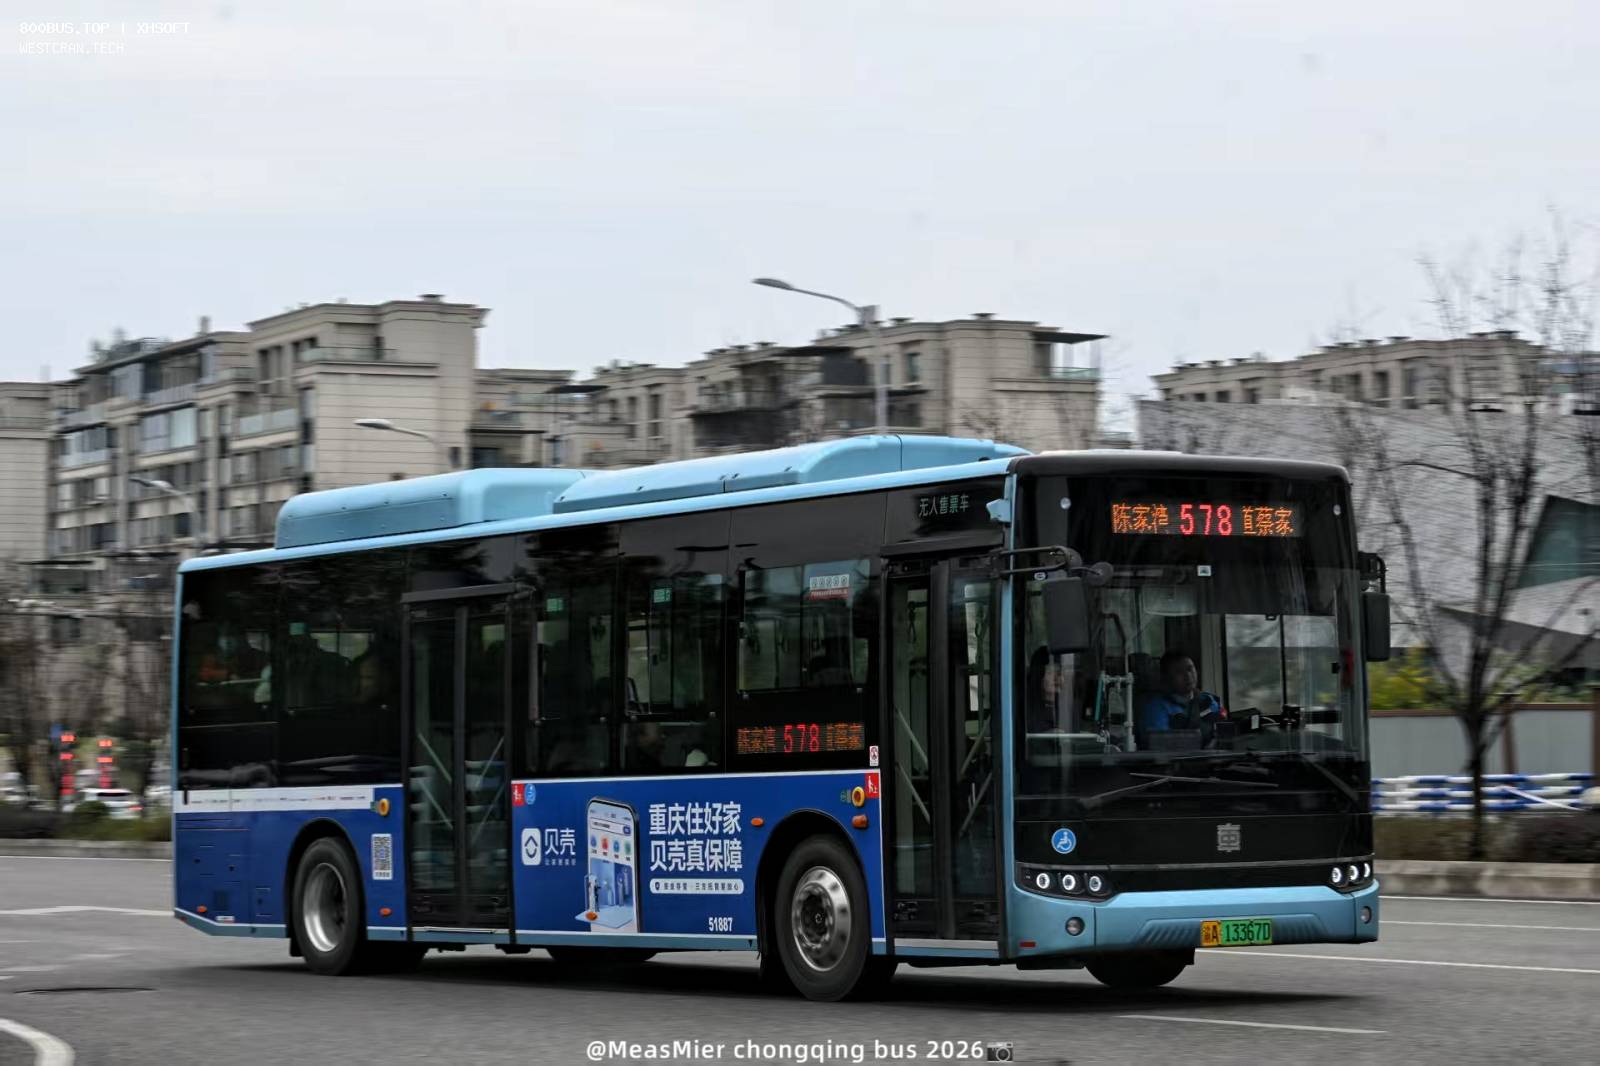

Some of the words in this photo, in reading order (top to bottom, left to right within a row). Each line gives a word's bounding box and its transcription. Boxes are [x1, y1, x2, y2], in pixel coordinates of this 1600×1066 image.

[919, 494, 969, 517] 无人售票车
[1178, 504, 1233, 536] 578
[783, 724, 820, 752] 578
[648, 801, 742, 836] 重庆住好家
[544, 828, 577, 856] 贝壳
[649, 838, 743, 872] 贝壳真保障
[708, 917, 733, 932] 51887
